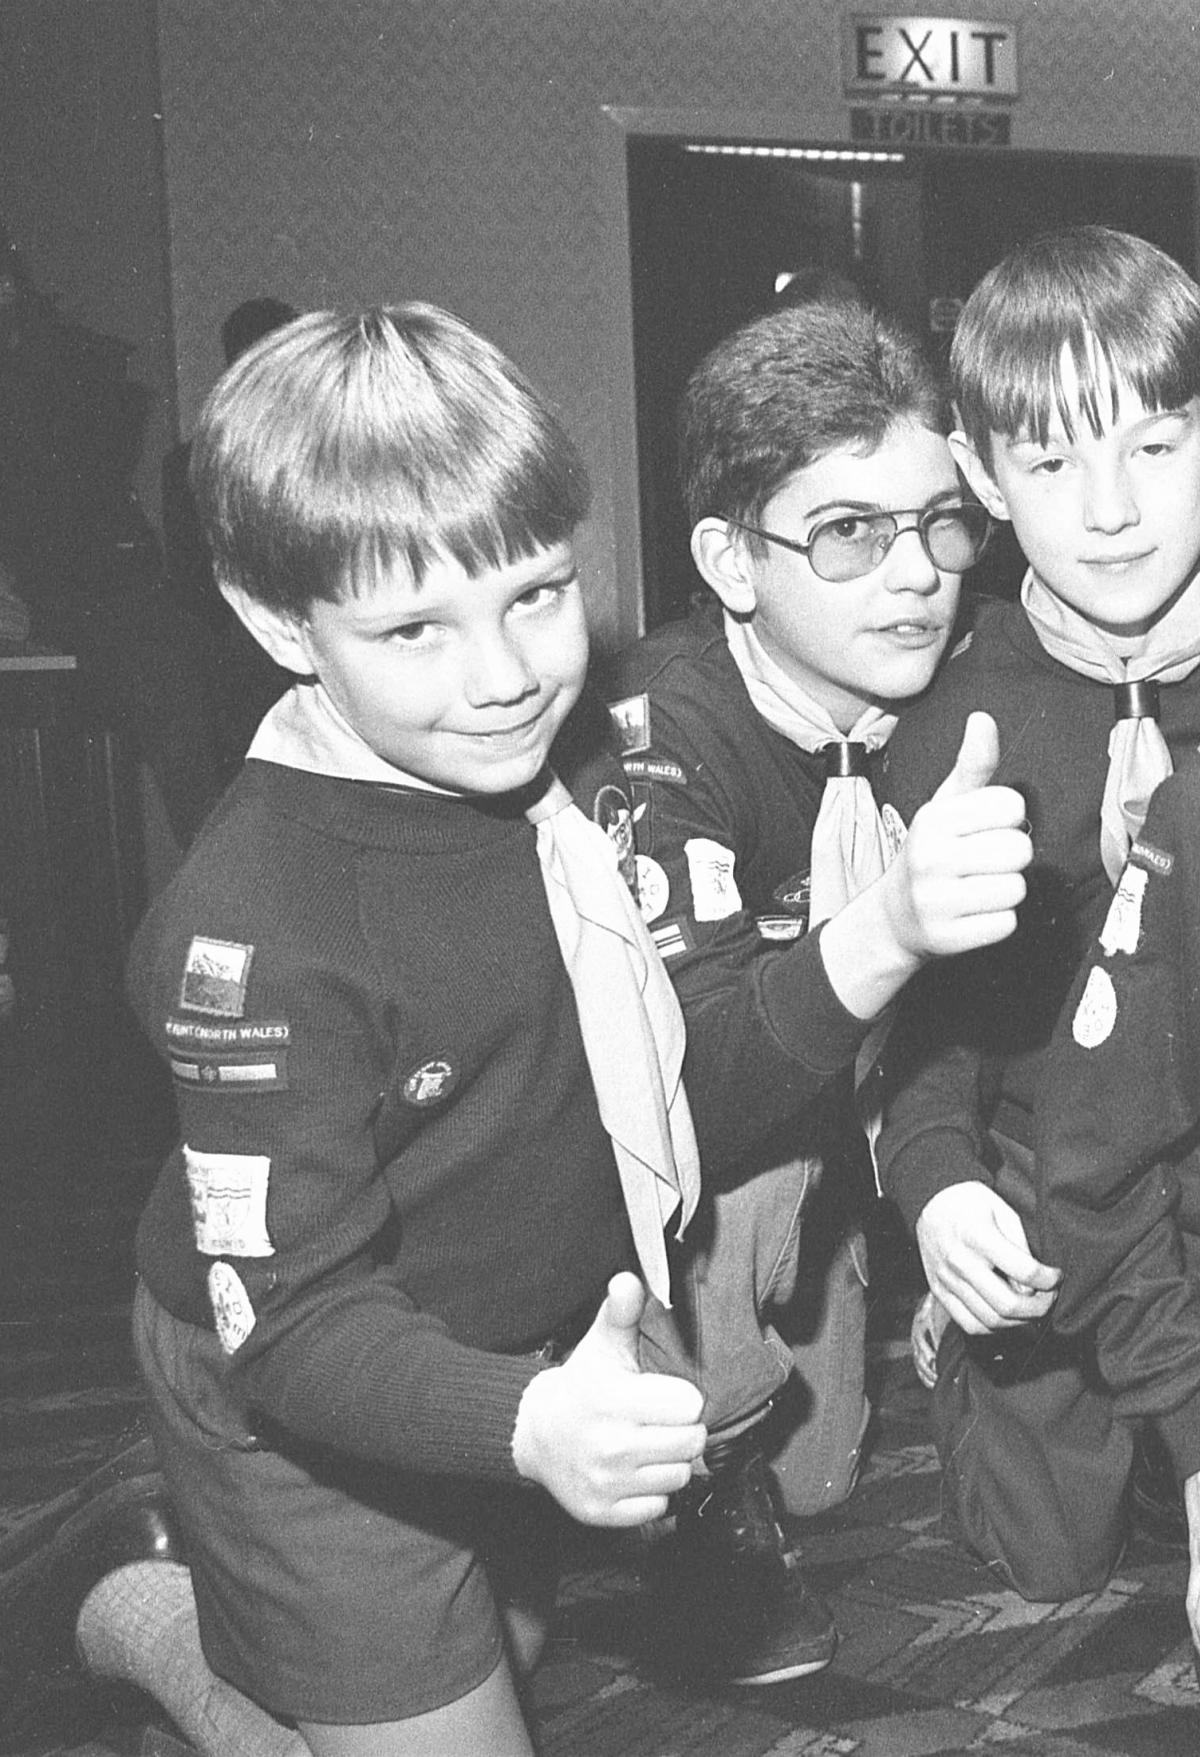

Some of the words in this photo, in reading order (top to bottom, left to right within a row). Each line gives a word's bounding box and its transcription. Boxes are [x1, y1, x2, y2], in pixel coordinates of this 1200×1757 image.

[856, 26, 1007, 84] EXIT
[867, 108, 998, 146] TOILETS
[239, 1026, 289, 1039] WALES)
